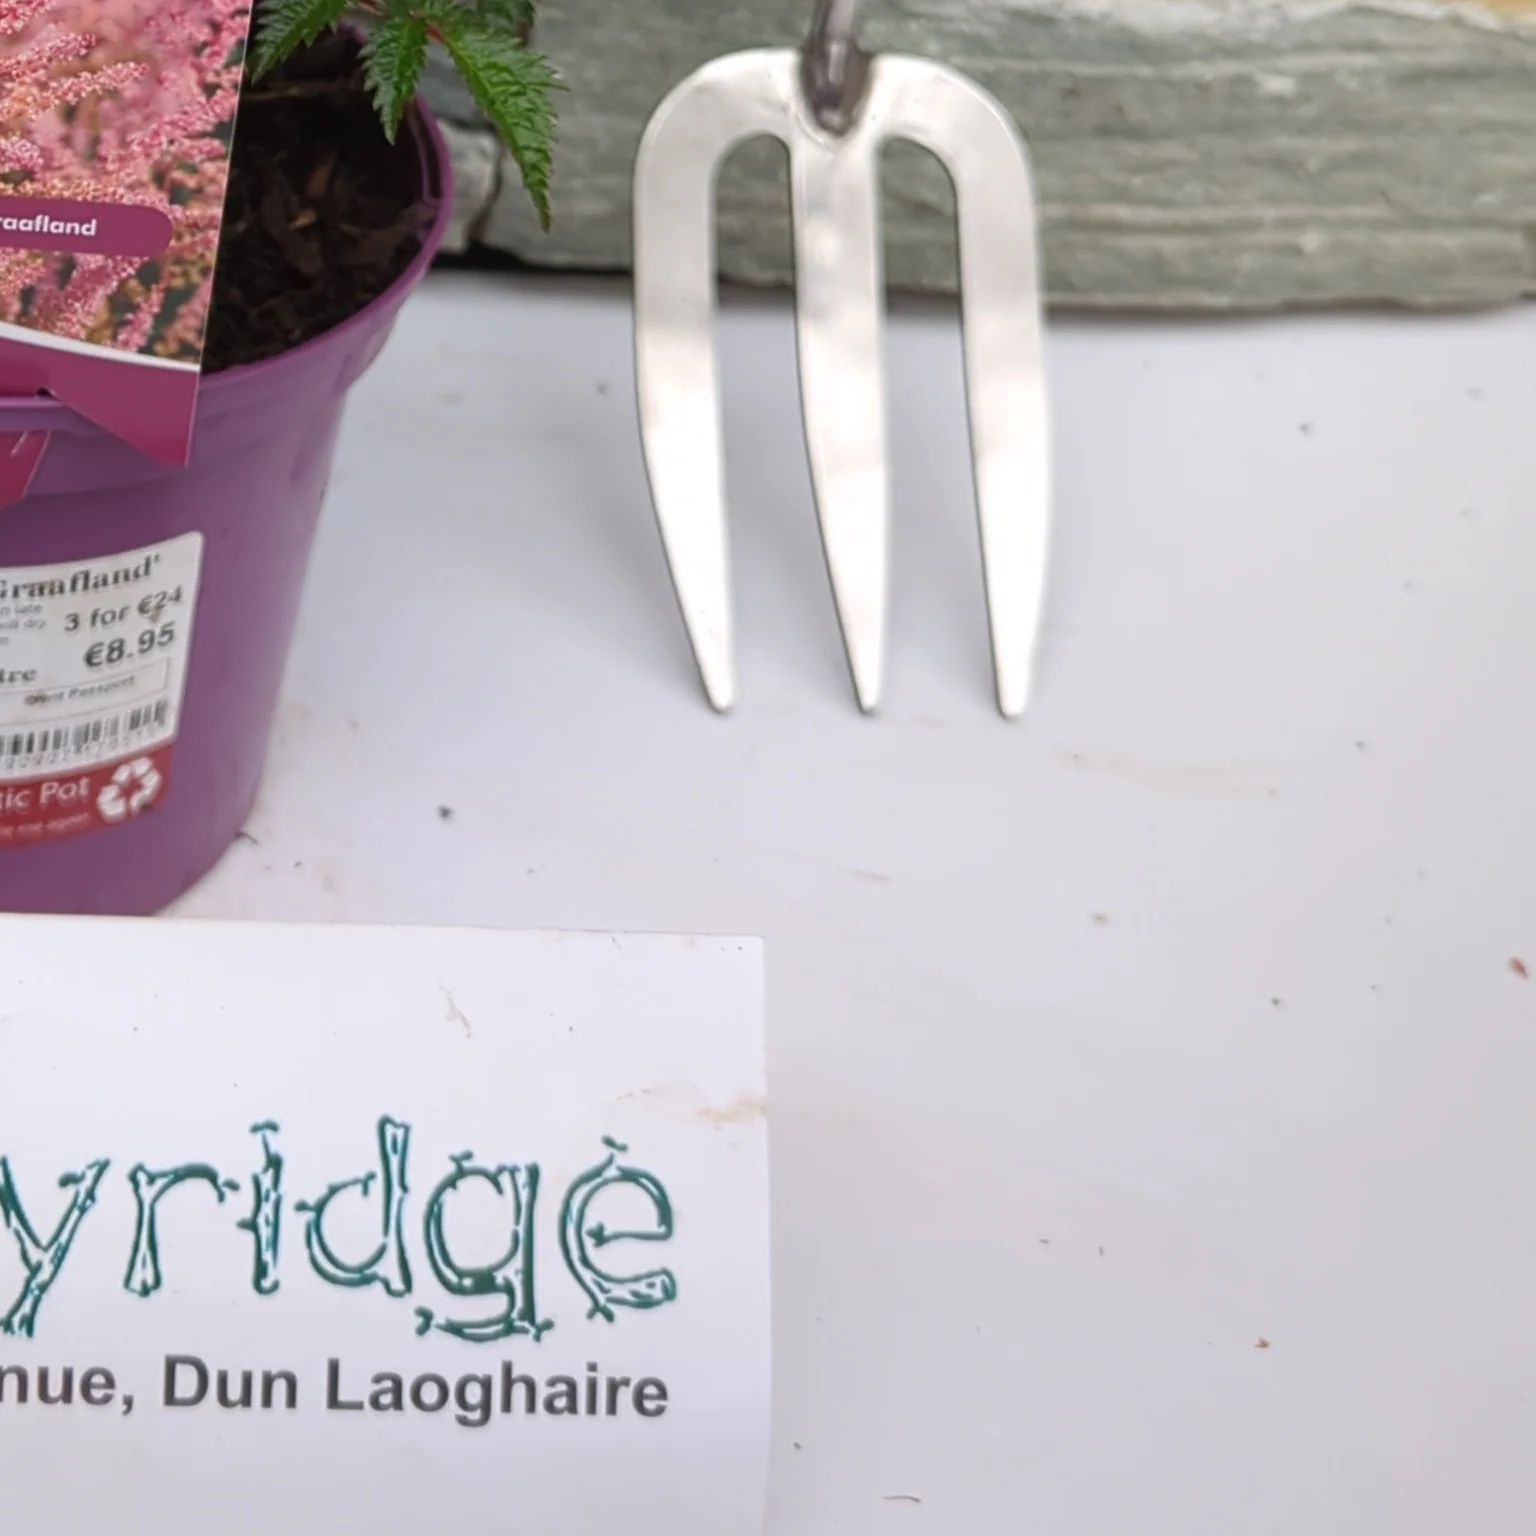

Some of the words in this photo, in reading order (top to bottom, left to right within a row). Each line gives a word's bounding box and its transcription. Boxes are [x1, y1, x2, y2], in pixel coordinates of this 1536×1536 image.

[64, 612, 80, 632] 3
[90, 605, 130, 628] for
[137, 585, 183, 615] €24
[83, 621, 175, 668] €8.95
[40, 777, 91, 805] Pot
[163, 1356, 298, 1411] Dun
[326, 1360, 668, 1427] Laoghaire
